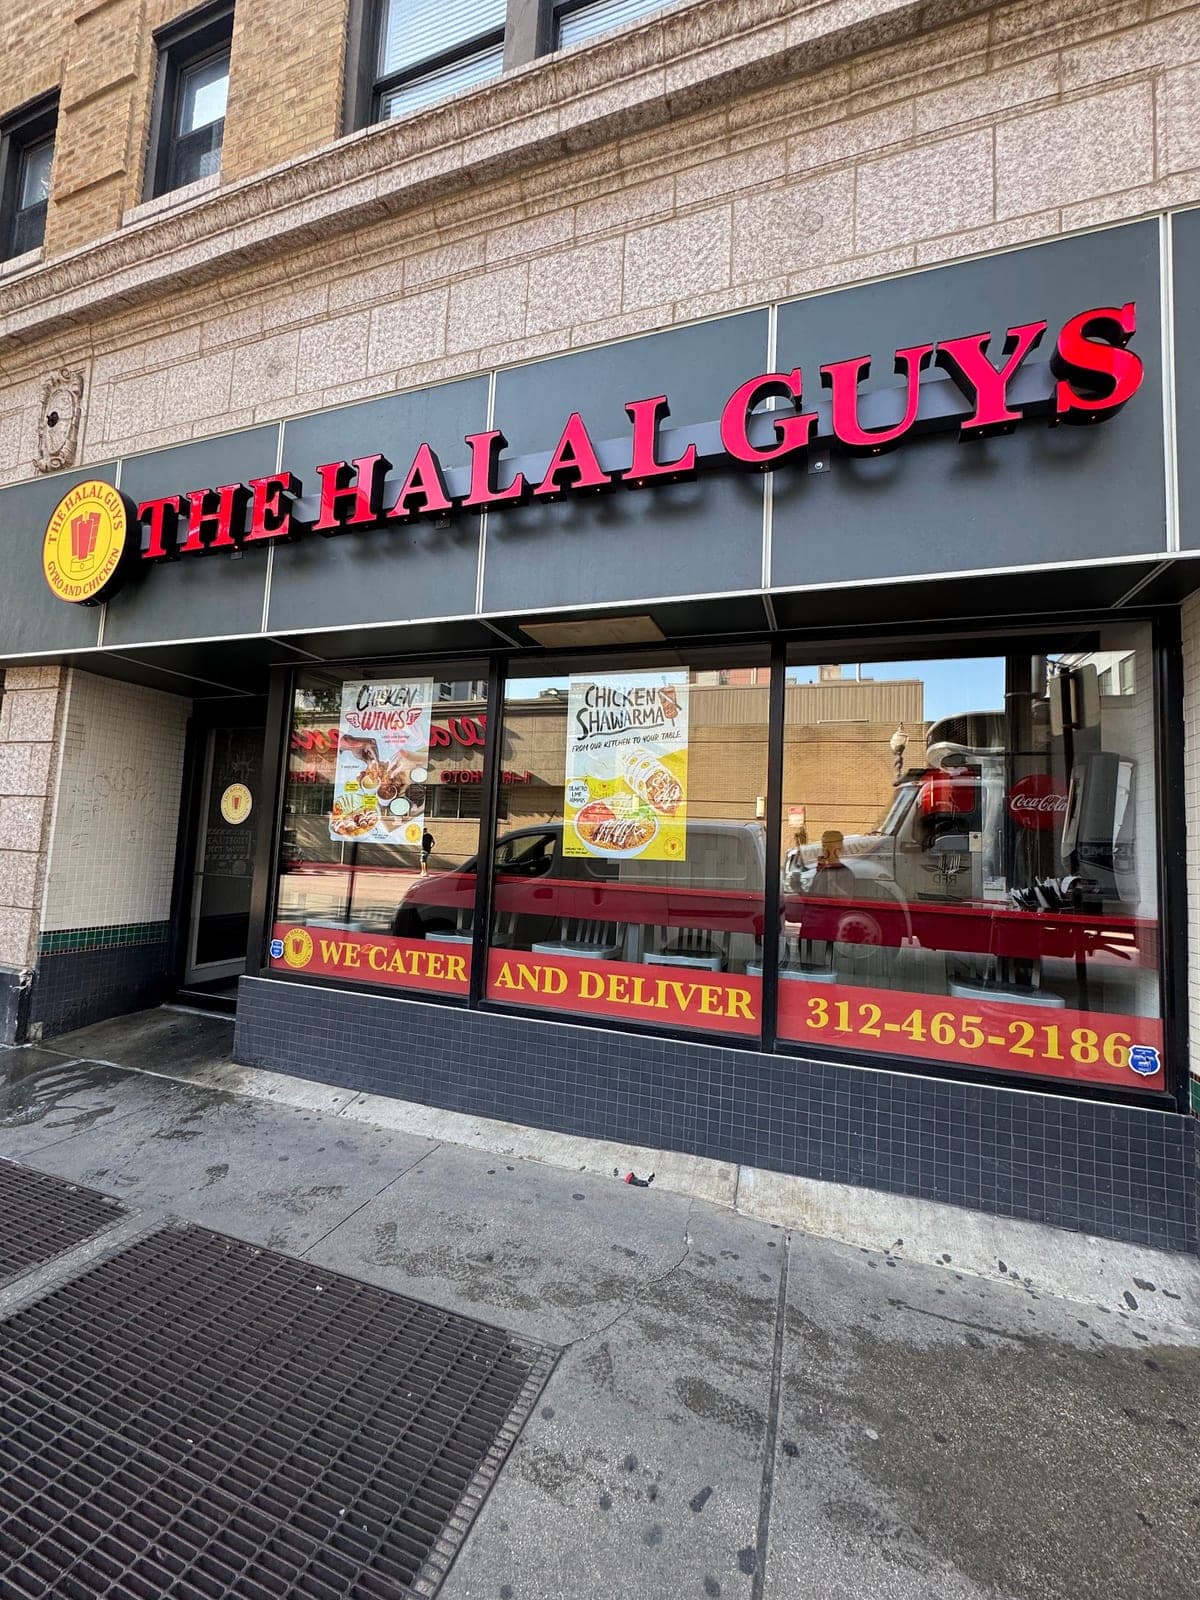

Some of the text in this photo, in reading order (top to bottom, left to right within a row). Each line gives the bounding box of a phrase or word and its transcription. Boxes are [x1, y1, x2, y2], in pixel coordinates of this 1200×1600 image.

[137, 301, 1145, 560] THE HALAL GUYS
[48, 484, 123, 545] THE HALAL GUYS
[47, 547, 121, 597] GYRO AND CHICKEN
[361, 710, 406, 731] WINGS
[585, 685, 656, 708] CHICKEN
[571, 730, 683, 753] FROM OUR KITCHEN TO YOUR TABLE
[576, 706, 665, 741] SHAWARMA
[319, 939, 361, 968] WE
[368, 945, 469, 982] CATER
[494, 961, 569, 994] AND
[578, 971, 756, 1020] DELIVER
[805, 997, 1132, 1068] 312-465-2186
